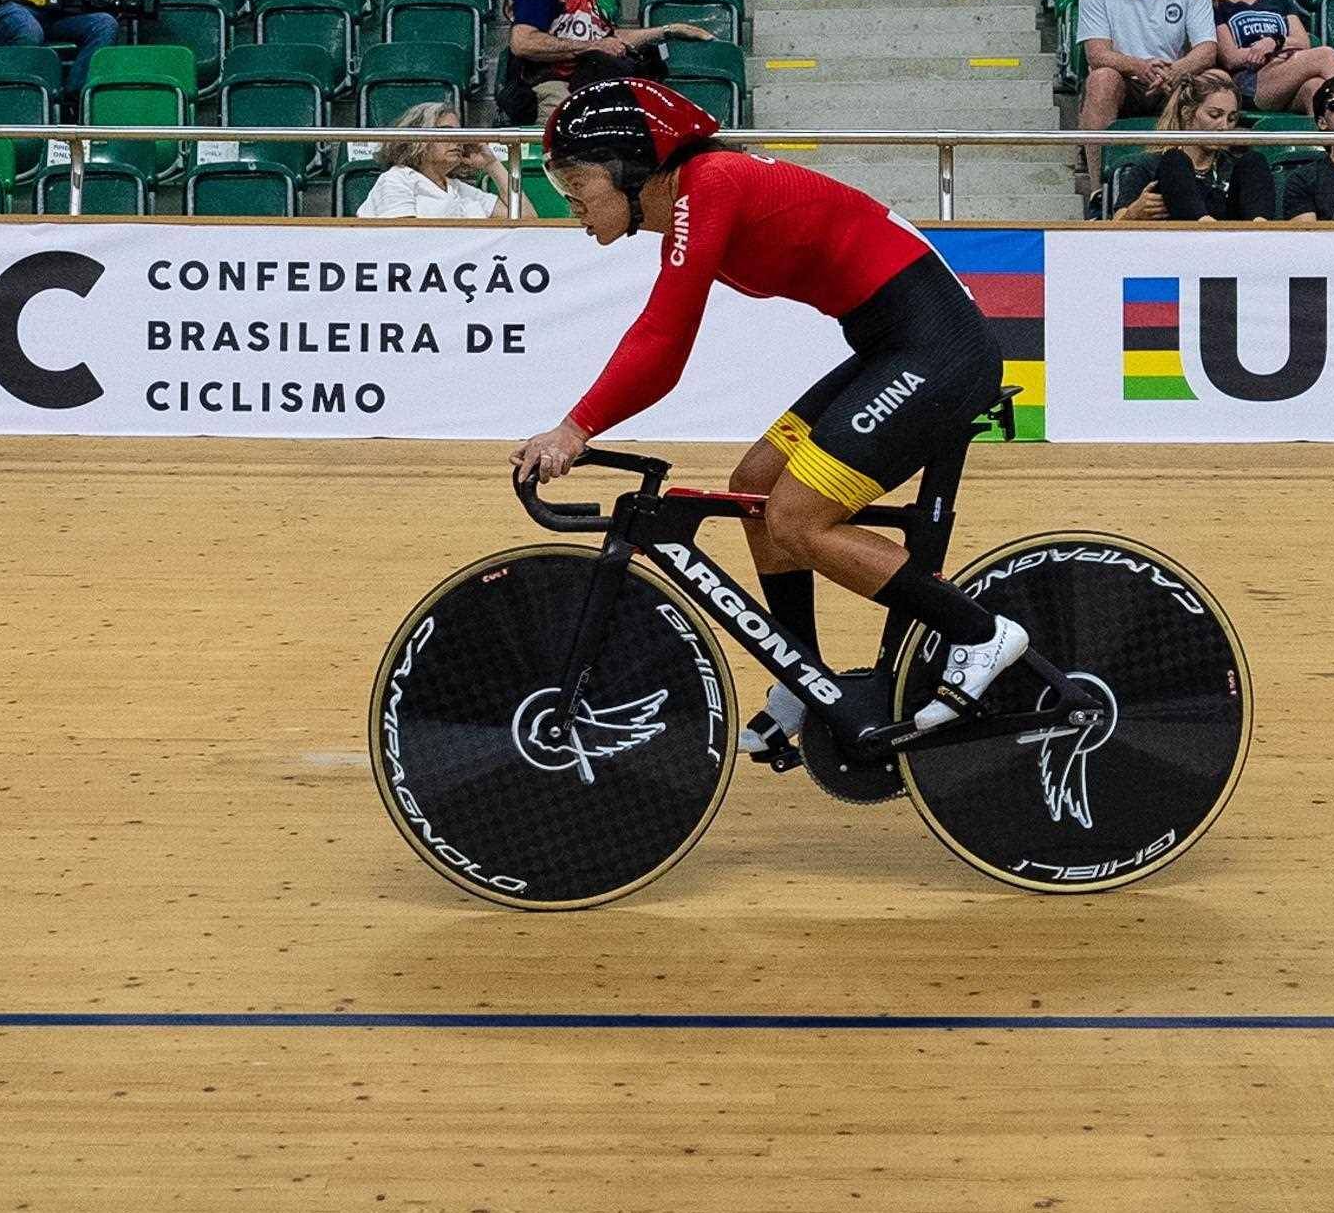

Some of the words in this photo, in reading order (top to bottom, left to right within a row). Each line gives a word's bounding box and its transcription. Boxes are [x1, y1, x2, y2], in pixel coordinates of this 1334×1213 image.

[1243, 22, 1279, 36] CYCLING
[670, 194, 690, 267] CHINA
[147, 254, 551, 305] CONFEDERAÇÃO
[147, 320, 441, 354] BRASILEIRA
[466, 323, 526, 354] DE
[146, 381, 386, 414] CICLISMO
[851, 371, 926, 434] CHINA
[653, 542, 802, 668] ARGON
[797, 663, 843, 705] 18
[383, 616, 527, 893] CAMPAGNOLO
[1006, 828, 1177, 881] GHIBLI
